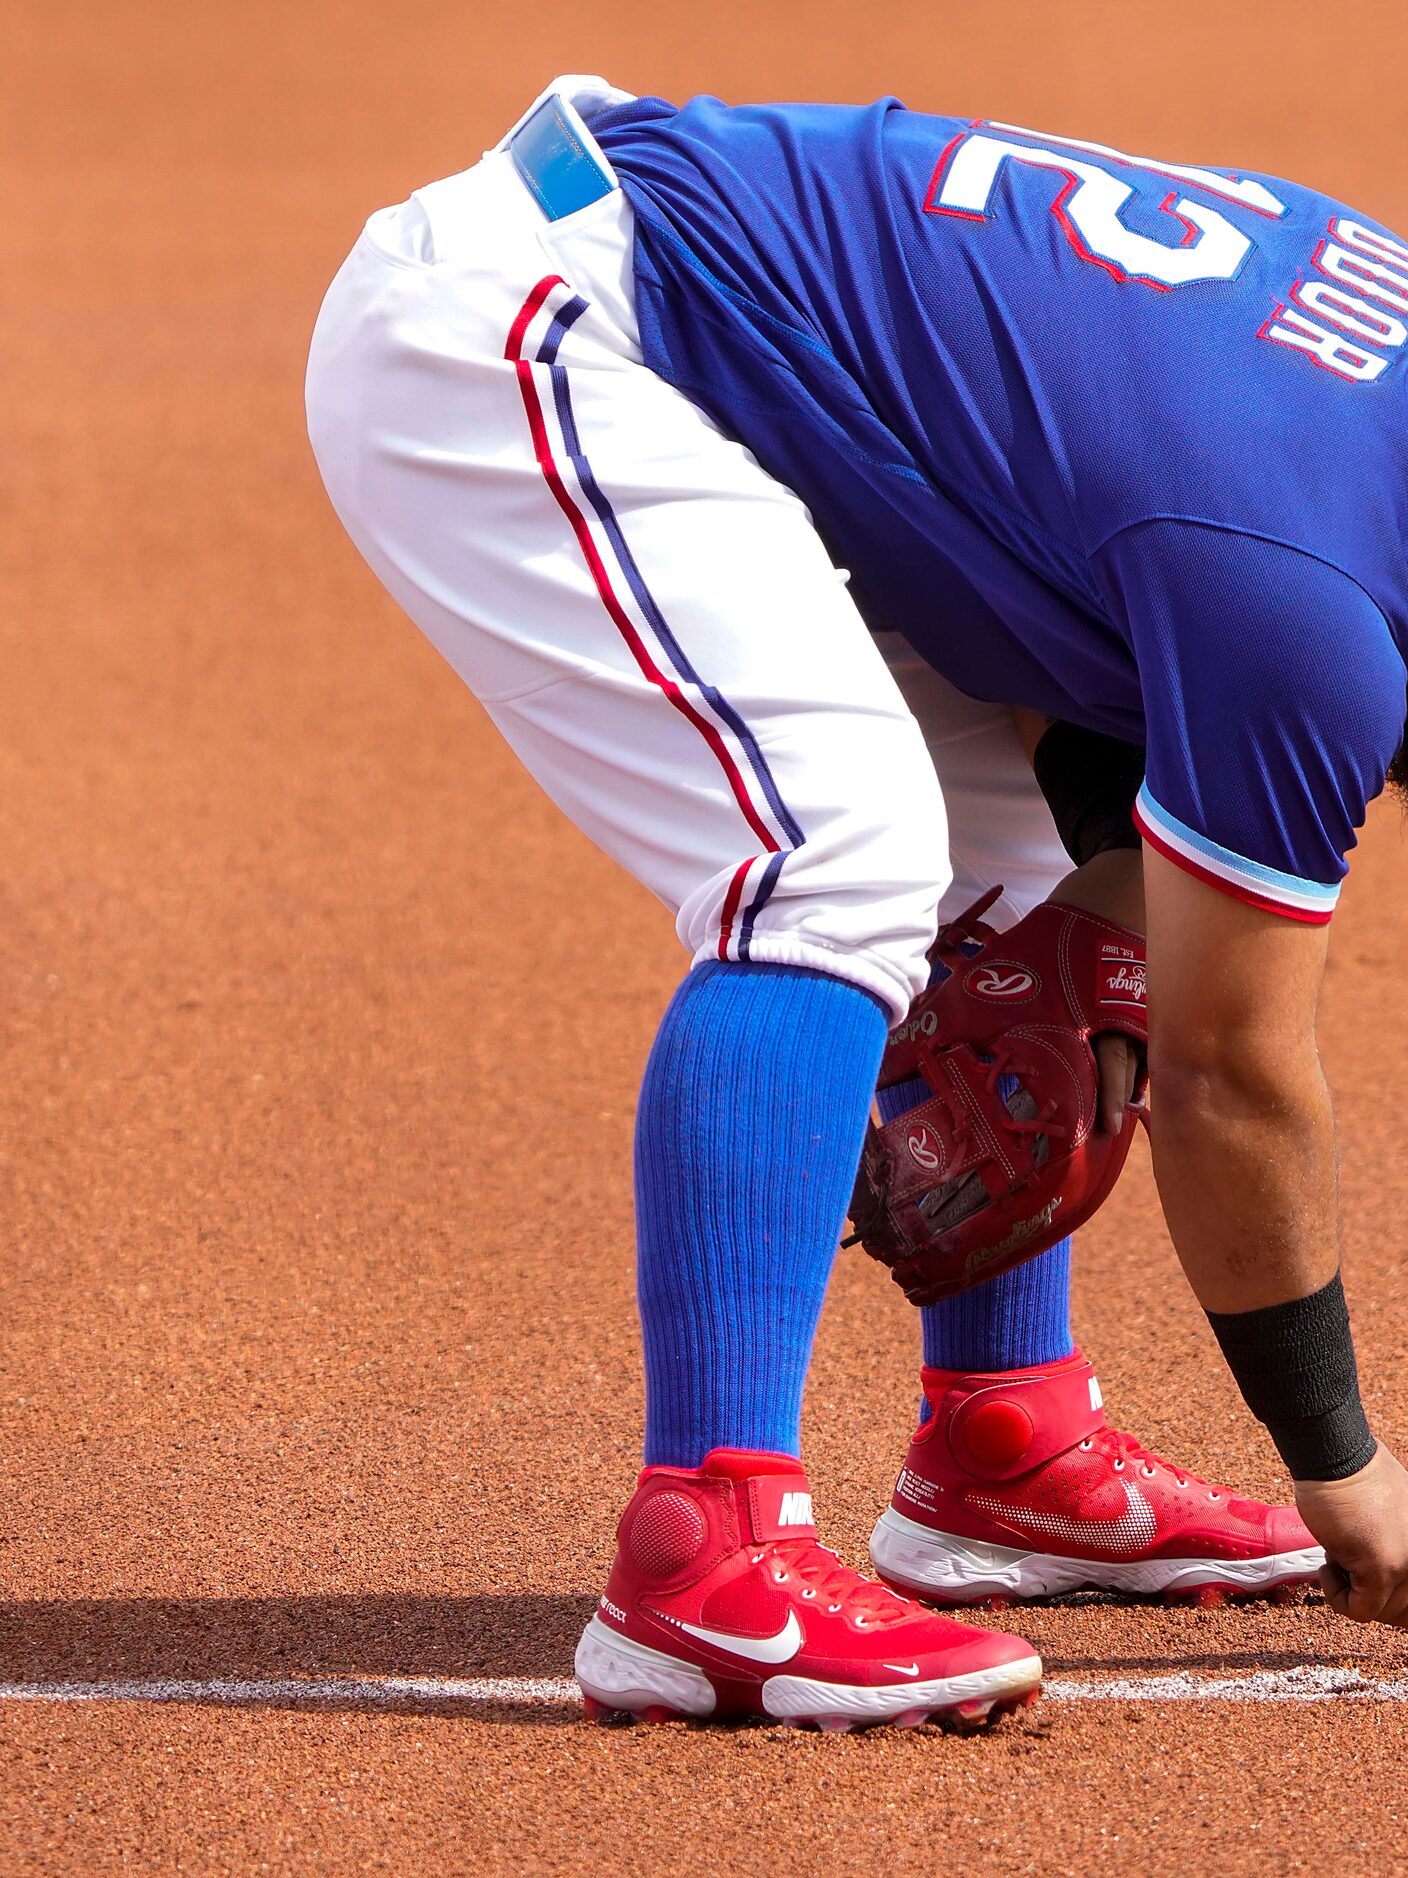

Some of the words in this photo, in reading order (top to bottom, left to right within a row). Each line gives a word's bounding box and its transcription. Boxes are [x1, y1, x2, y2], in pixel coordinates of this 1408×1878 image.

[1102, 945, 1119, 955] 1887
[1120, 947, 1134, 958] Est.
[1106, 967, 1146, 1000] wlings
[778, 1492, 815, 1526] NIK
[606, 1602, 627, 1623] react
